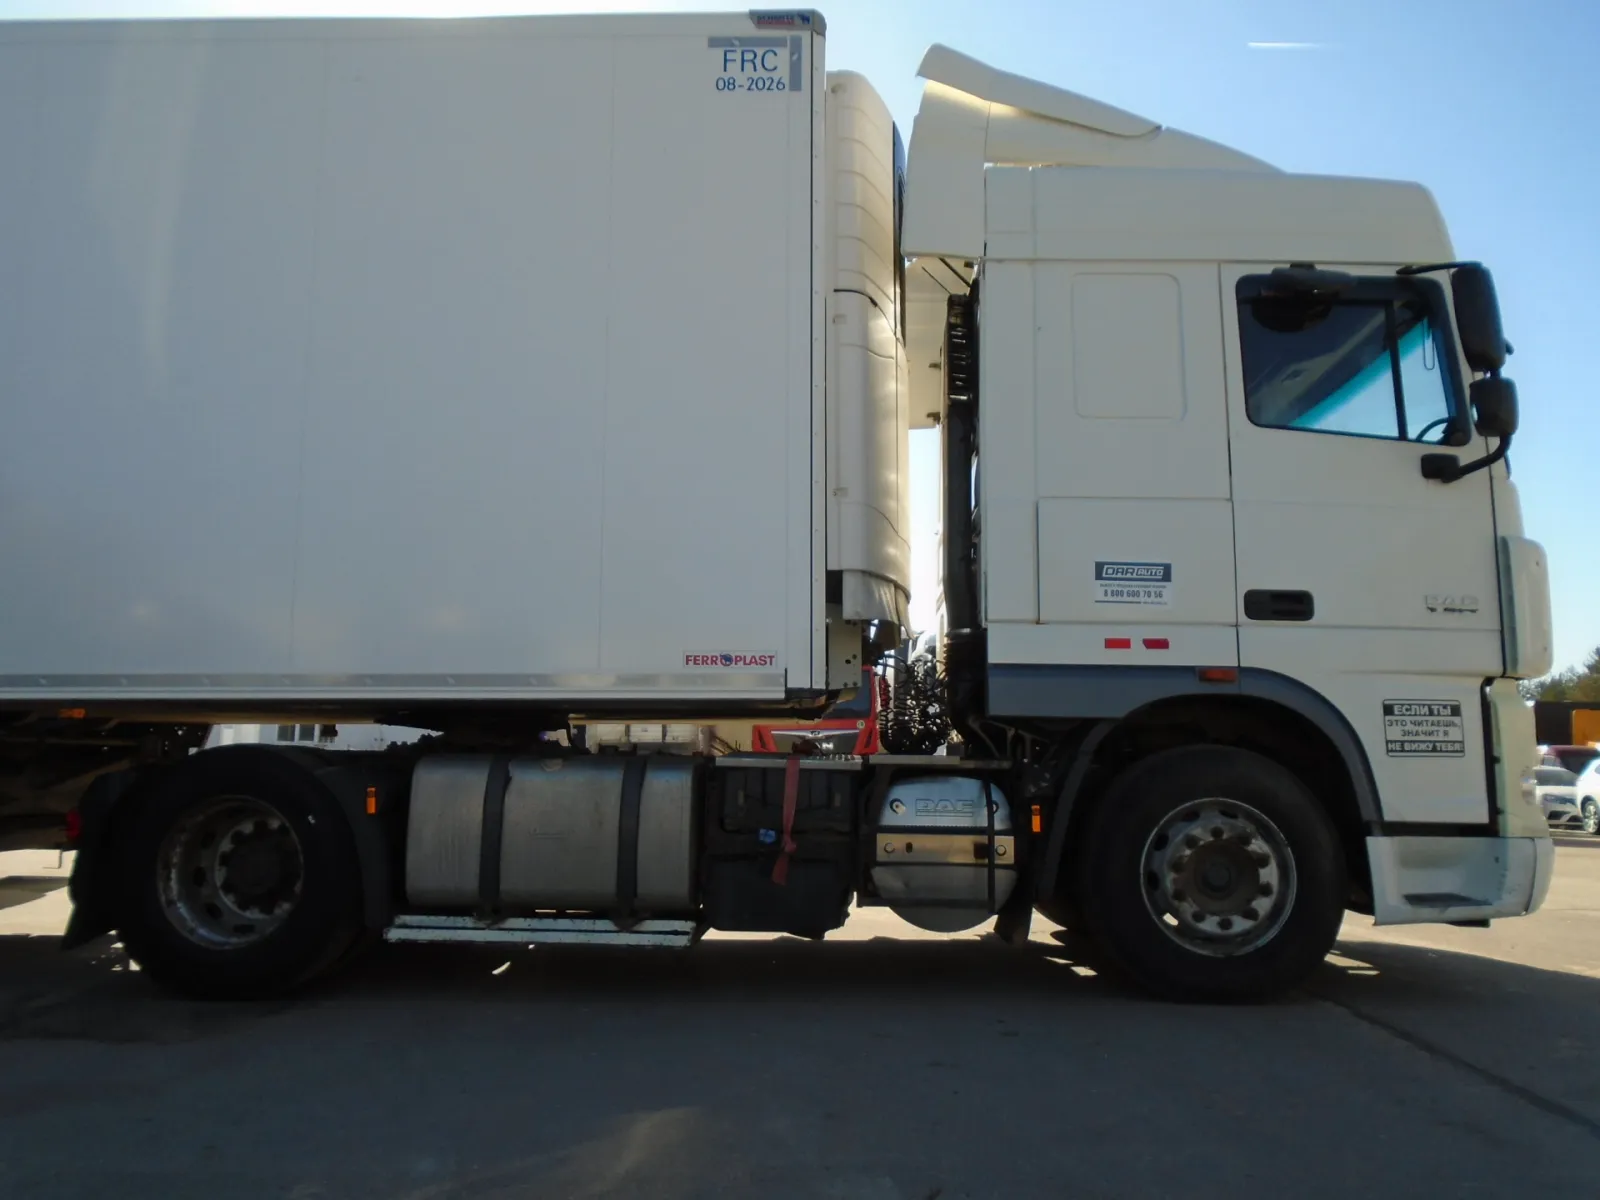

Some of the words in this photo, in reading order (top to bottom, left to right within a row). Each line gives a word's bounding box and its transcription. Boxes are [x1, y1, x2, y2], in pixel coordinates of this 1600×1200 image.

[723, 49, 778, 72] FRC
[715, 76, 786, 91] 08-2026
[1111, 589, 1124, 597] 800
[1126, 590, 1140, 598] 600
[685, 653, 775, 667] FERROPLAST
[1394, 704, 1429, 715] ЕСЛИ
[1431, 705, 1451, 715] ТЫ
[1387, 719, 1407, 727] ЭТО
[1401, 729, 1440, 737] ЗНАЧИТ
[1388, 742, 1402, 751] НЕ
[1404, 742, 1433, 751] ВИЖУ
[915, 799, 974, 813] DAF
